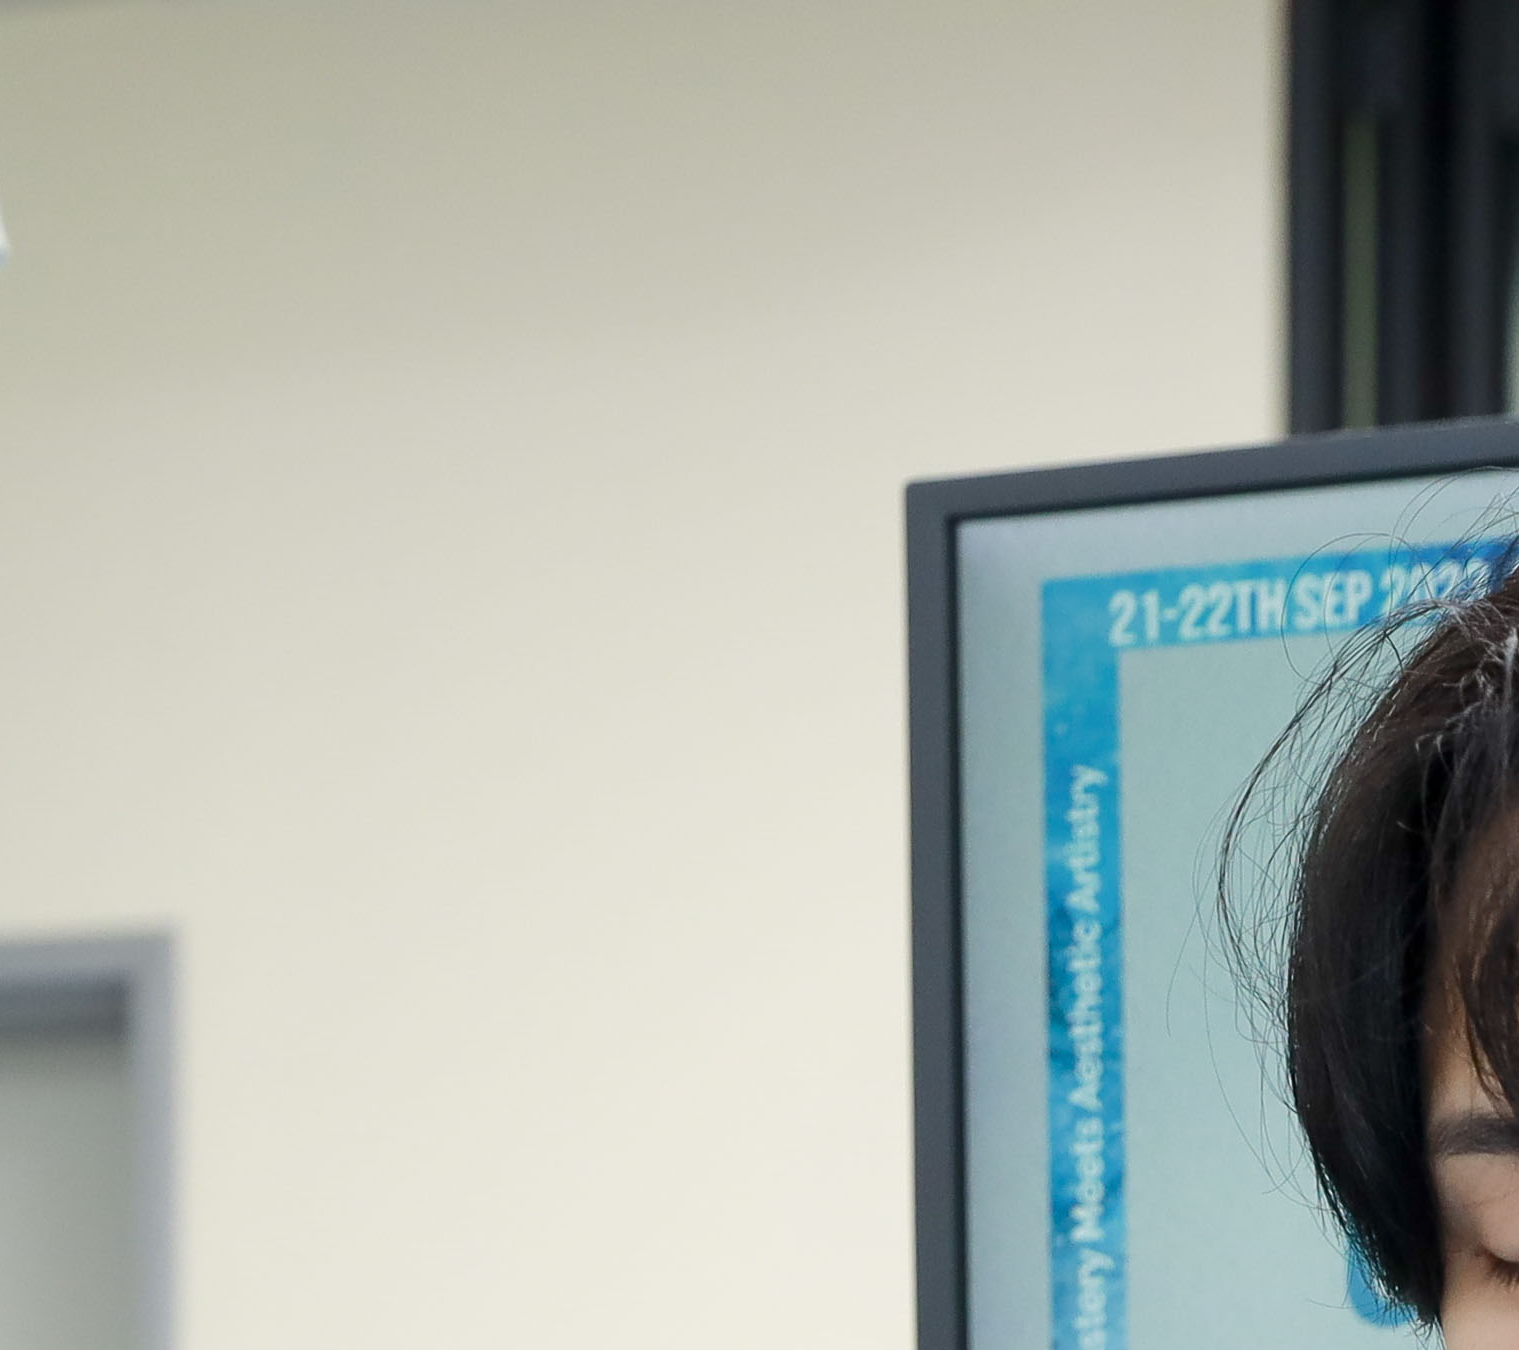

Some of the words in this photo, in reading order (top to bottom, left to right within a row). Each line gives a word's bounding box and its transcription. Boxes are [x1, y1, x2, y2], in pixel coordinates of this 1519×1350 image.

[1108, 577, 1288, 647] 21-22TH
[1293, 569, 1374, 631] SEP
[1066, 764, 1109, 914] Artistry
[1067, 917, 1104, 1112] Aesthetic
[1068, 1116, 1106, 1244] Meets
